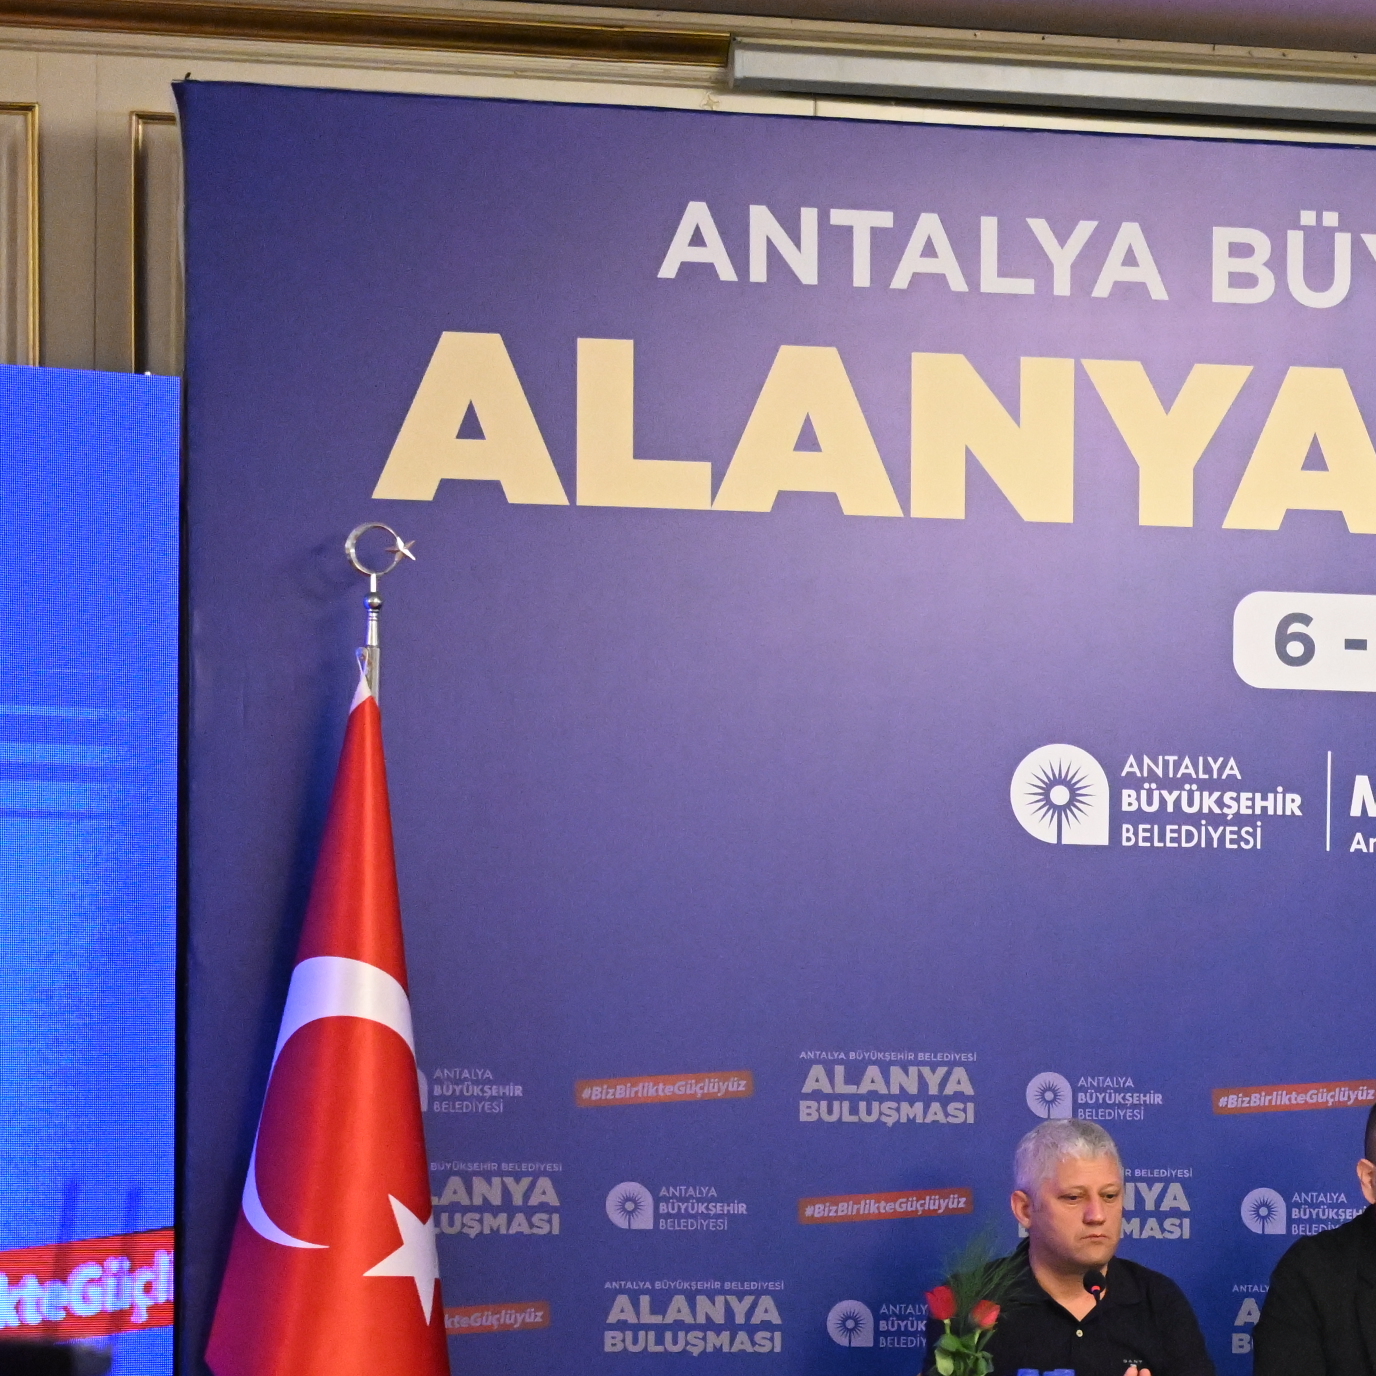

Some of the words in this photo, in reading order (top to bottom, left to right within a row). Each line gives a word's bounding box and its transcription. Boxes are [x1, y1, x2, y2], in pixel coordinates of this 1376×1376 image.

[659, 202, 1170, 302] ANTALYA
[1275, 613, 1315, 667] 6
[1121, 755, 1241, 779] ANTALYA
[1121, 783, 1302, 821] BÜYÜKŞEHİR
[1121, 820, 1262, 849] BELEDİYESİ
[799, 1050, 847, 1060] ANTALYA
[848, 1049, 915, 1063] BÜYÜKŞEHİR
[917, 1052, 977, 1062] BELEDİYESİ
[433, 1067, 494, 1080] ANTALYA
[802, 1065, 974, 1095] ALANYA
[1077, 1076, 1135, 1088] ANTALYA
[434, 1081, 522, 1097] BÜYÜKŞEHİR
[582, 1077, 747, 1100] #BizBirlikteGüçlüyüz
[1219, 1087, 1374, 1108] #BizBirlikteGüçlüyüz
[434, 1098, 503, 1113] BELEDİYESİ
[1078, 1090, 1162, 1106] BÜYÜKŞEHİR
[800, 1101, 974, 1126] BULUŞMASI
[1078, 1105, 1144, 1120] BELEDİYESİ
[500, 1161, 563, 1172] BELEDİYESİ
[1134, 1167, 1193, 1178] BELEDİYESİ
[432, 1176, 561, 1206] ANYA
[659, 1185, 718, 1198] ANTALYA
[1291, 1192, 1348, 1204] ANTALYA
[660, 1200, 747, 1215] BÜYÜKŞEHİR
[805, 1195, 966, 1217] #BizBirlikteGüçlüyüz
[434, 1211, 561, 1239] UŞMASI
[658, 1216, 728, 1231] BELEDİYESİ
[604, 1280, 653, 1290] ANTALYA
[654, 1279, 722, 1291] BÜYÜKŞEHİR
[723, 1280, 785, 1291] BELEDİYESİ
[607, 1295, 781, 1324] ALANYA
[604, 1331, 781, 1356] BULUŞMASI
